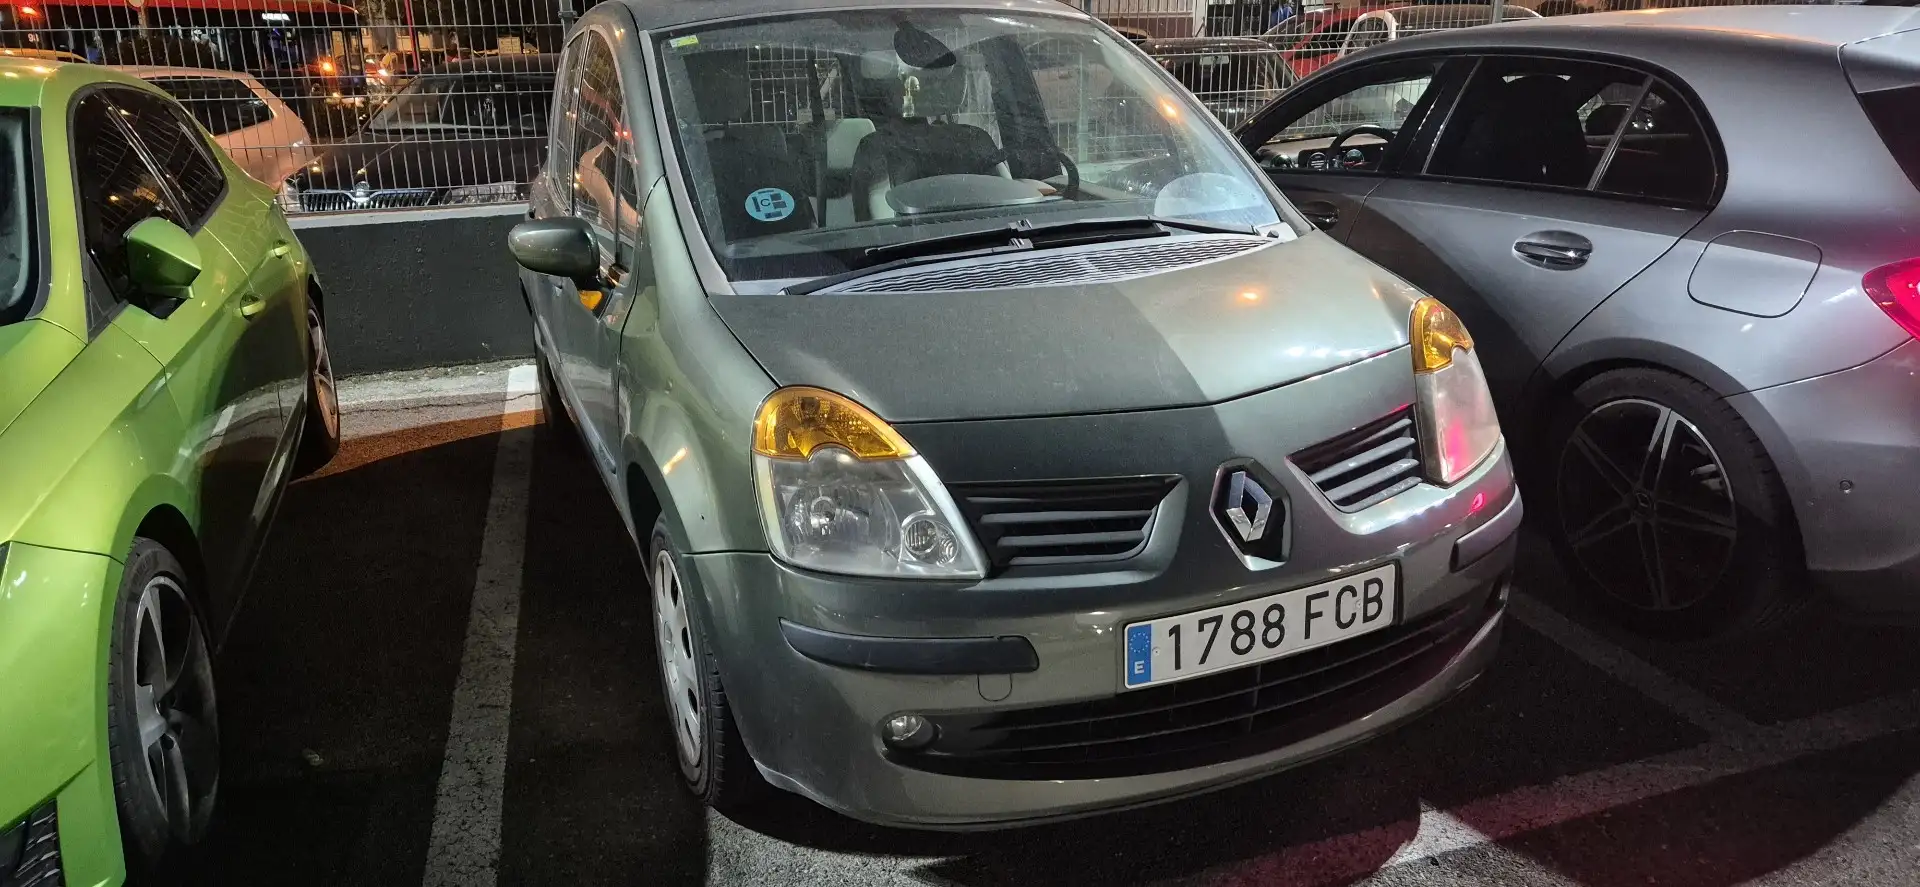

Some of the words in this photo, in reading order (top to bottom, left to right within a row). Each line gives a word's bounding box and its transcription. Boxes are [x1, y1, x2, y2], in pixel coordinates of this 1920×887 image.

[760, 198, 771, 207] C
[1168, 603, 1286, 671] 1788
[1304, 577, 1384, 640] FCB
[1134, 661, 1145, 675] E
